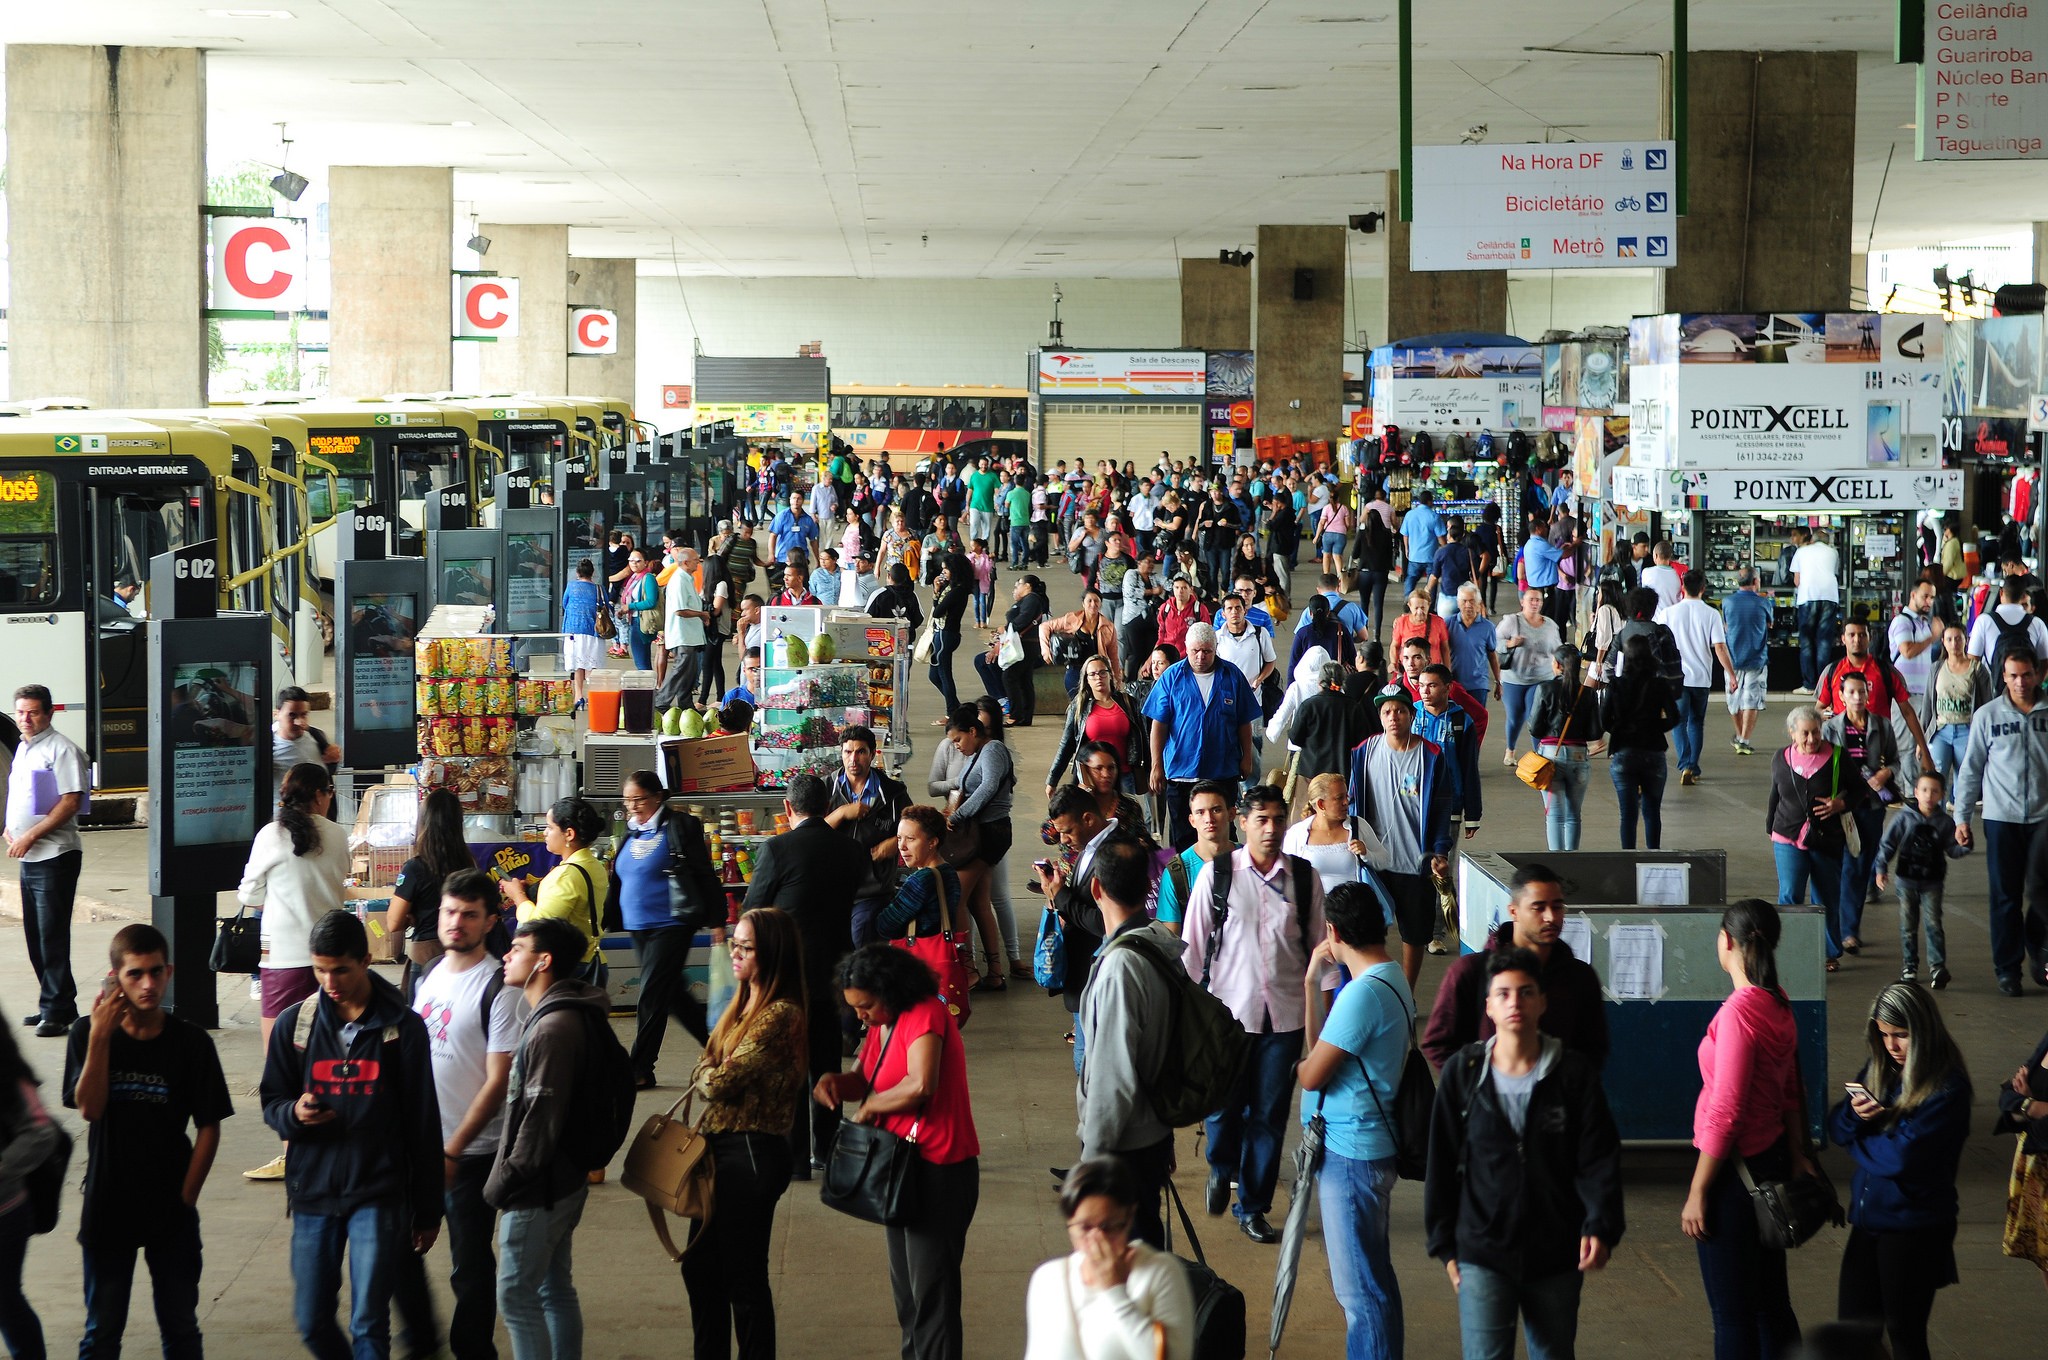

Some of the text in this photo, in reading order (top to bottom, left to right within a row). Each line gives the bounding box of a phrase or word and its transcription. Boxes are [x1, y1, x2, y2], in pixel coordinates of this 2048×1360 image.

[1937, 3, 2028, 19] Ceilândia
[1937, 25, 1997, 41] Guará
[1937, 48, 2032, 63] Guariroba
[1937, 69, 2048, 85] Núcleo Ban
[1936, 93, 1950, 107] P
[1936, 115, 1949, 129] P
[1936, 136, 2042, 154] Taguatinga
[1502, 153, 1604, 171] Na Hora DF
[1506, 194, 1604, 212] Bicicletário
[1477, 240, 1516, 250] Ceilândia
[1553, 237, 1605, 254] Metrô
[225, 227, 293, 298] C
[1466, 250, 1516, 261] Samambaia
[466, 284, 509, 328] C
[578, 315, 609, 347] C
[1690, 405, 1849, 431] POINTXCELL
[610, 450, 625, 460] C 07
[1736, 452, 1804, 461] (61) 3342-2263
[88, 466, 188, 475] ENTRADA ENTRANCE
[565, 462, 585, 474] C 06
[508, 476, 530, 488] C 05
[1734, 476, 1894, 502] POINTXCELL
[441, 493, 467, 506] C 04
[355, 515, 385, 531] C 03
[175, 559, 215, 579] C 02
[1991, 720, 2021, 737] MCM
[214, 749, 247, 757] Deputados
[197, 760, 217, 769] projeto
[202, 770, 224, 778] compra
[495, 847, 515, 864] De
[486, 853, 530, 882] Mntão
